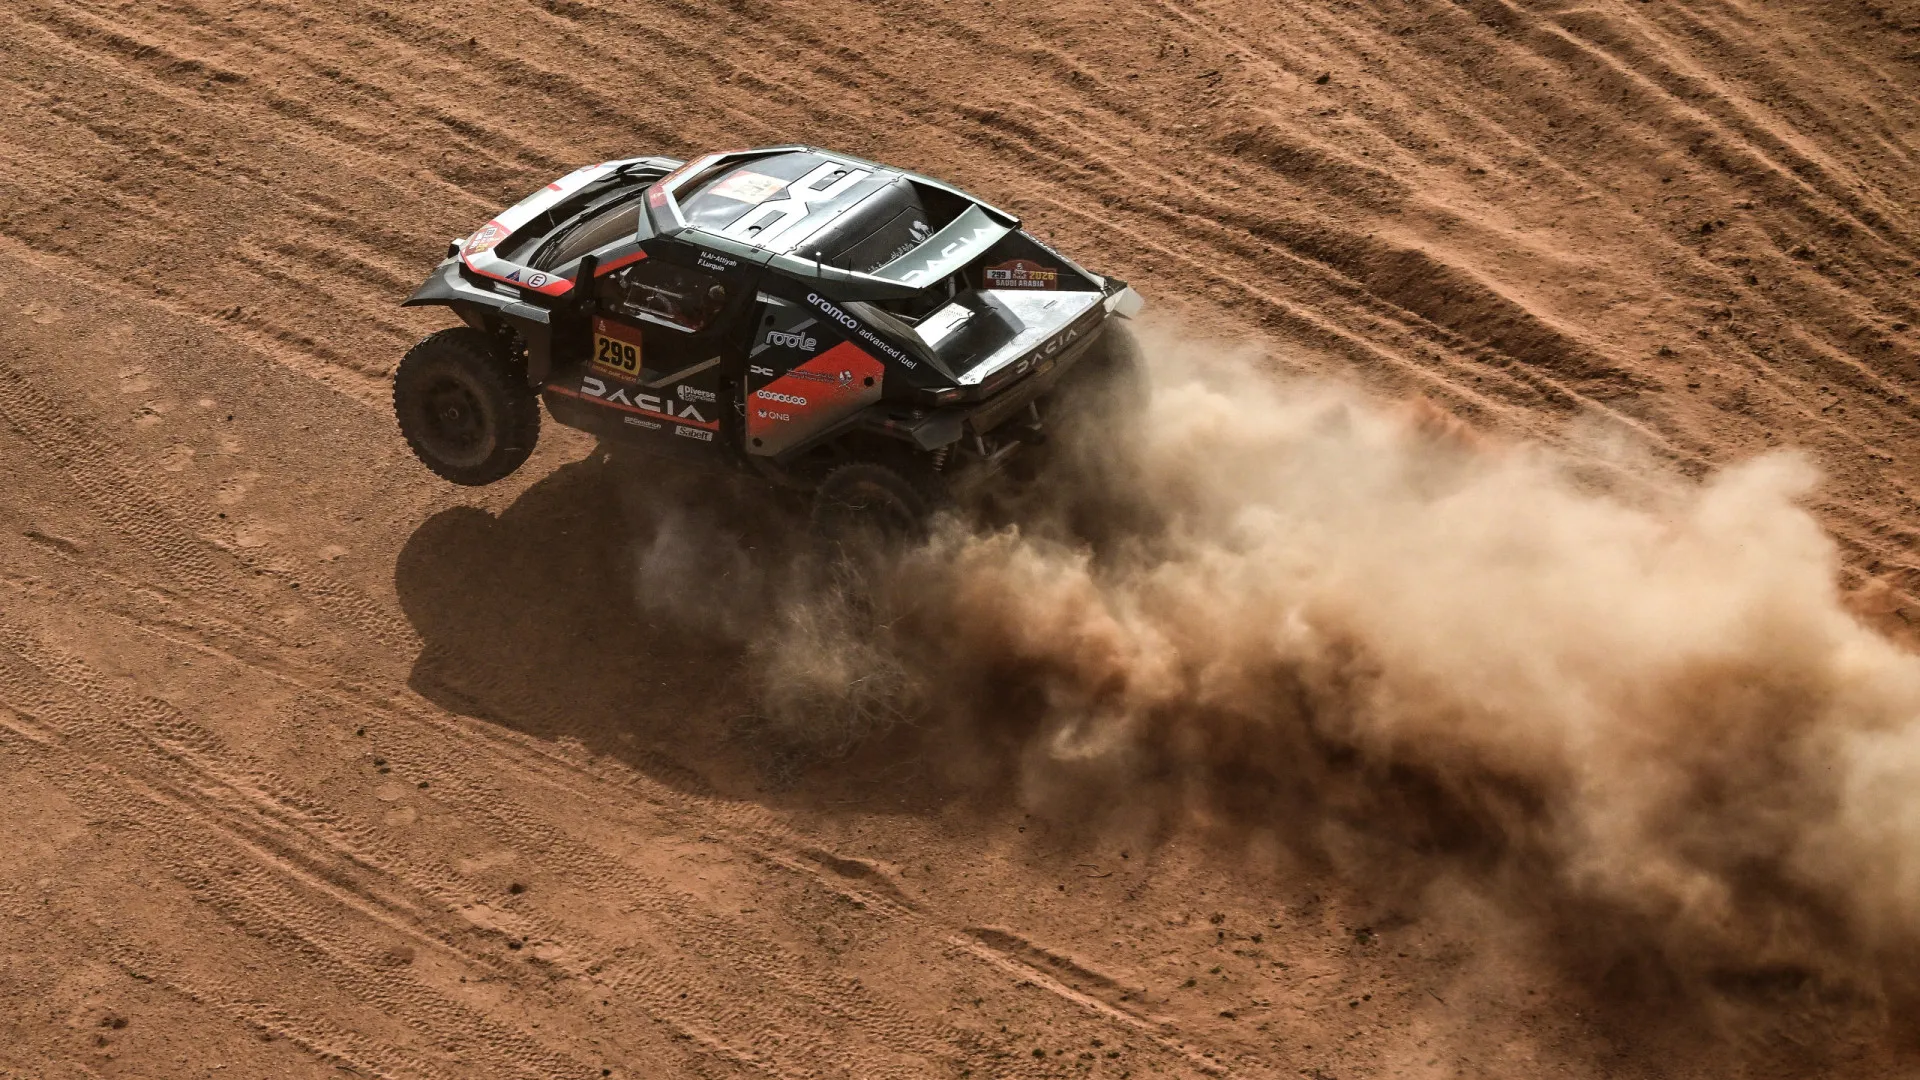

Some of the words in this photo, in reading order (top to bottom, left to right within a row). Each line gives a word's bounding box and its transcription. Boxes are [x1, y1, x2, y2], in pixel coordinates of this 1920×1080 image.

[700, 251, 737, 267] N.Al-Attiyah
[991, 271, 1006, 279] 299
[1029, 271, 1055, 280] 2026
[995, 279, 1017, 287] SAUDI
[806, 293, 858, 329] aramco
[859, 328, 900, 358] advanced
[898, 354, 917, 370] fuel
[598, 337, 637, 371] 299
[1015, 329, 1077, 374] DACIA
[684, 385, 716, 399] Diverse
[757, 390, 806, 405] ooredoo
[581, 376, 706, 423] DACIA
[768, 411, 790, 421] QNB
[680, 426, 709, 440] Sabelt
